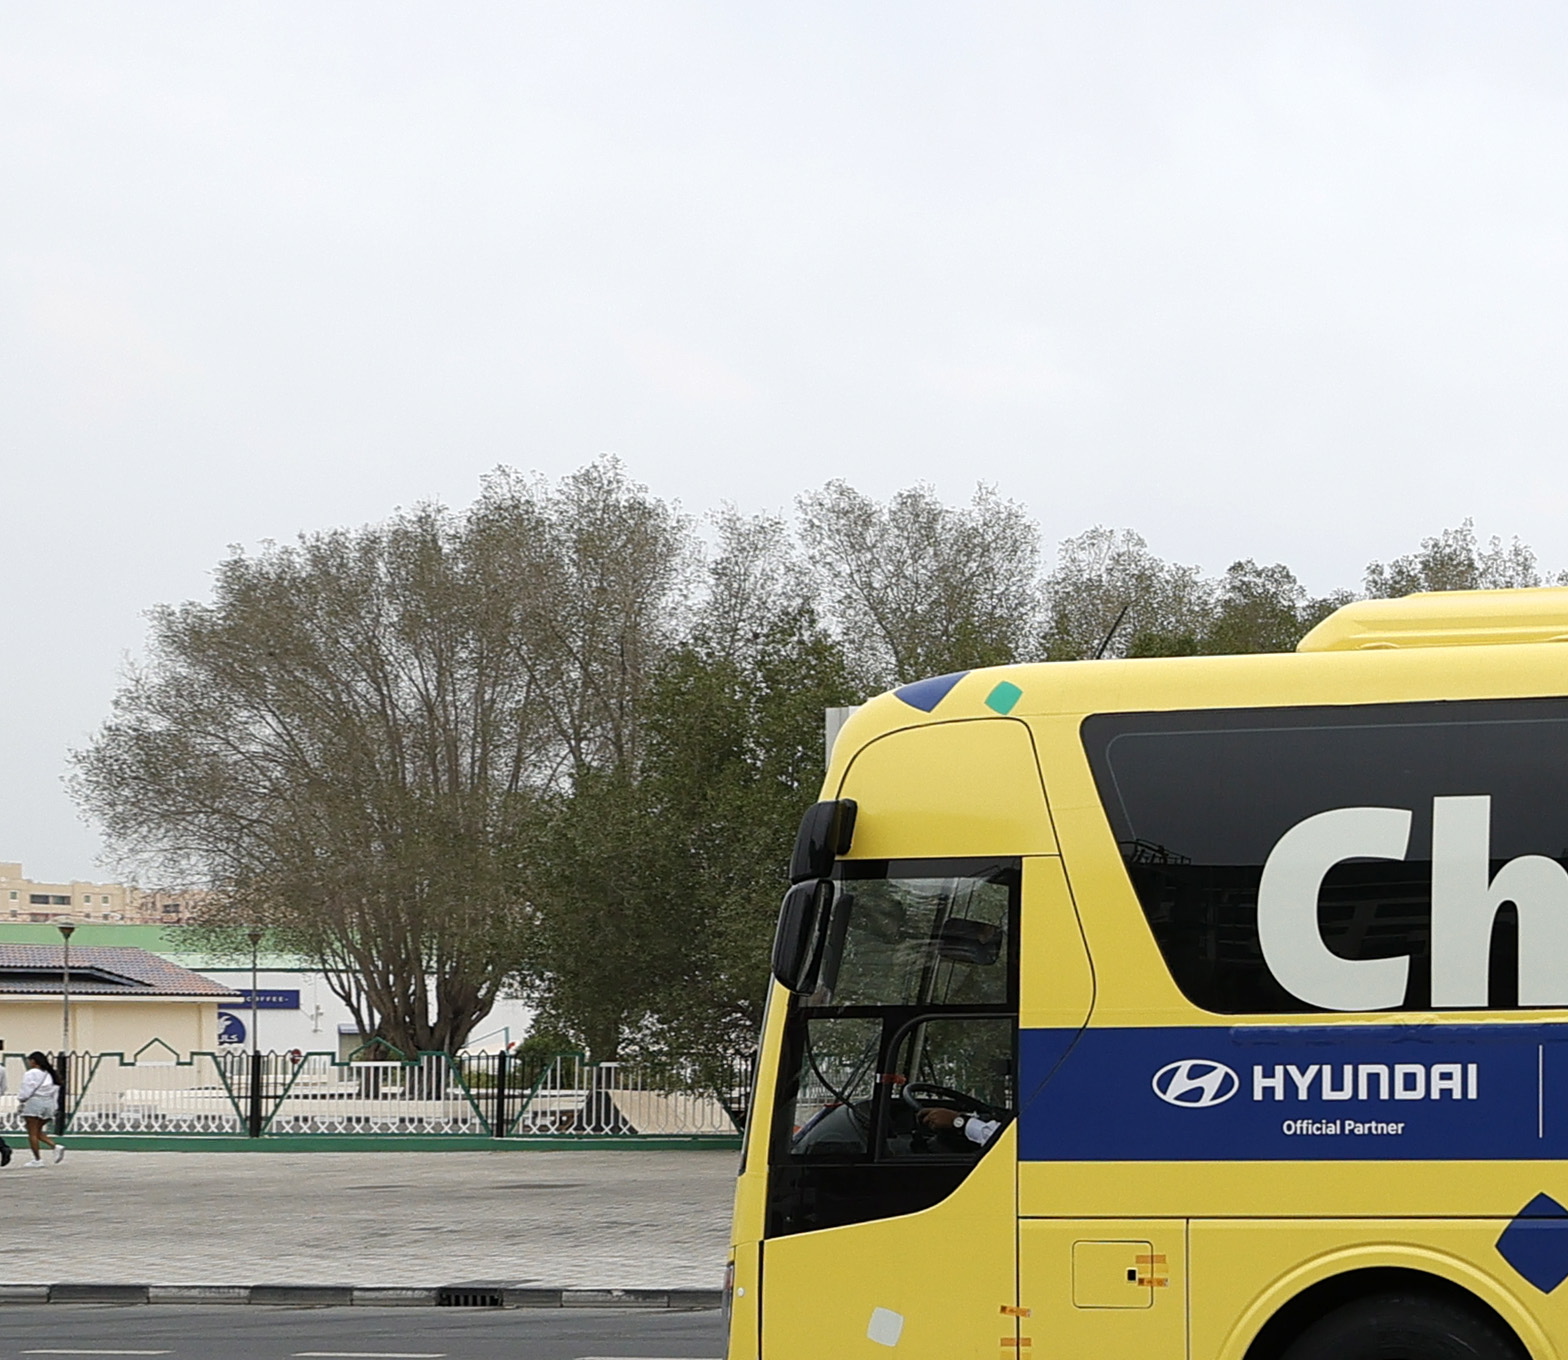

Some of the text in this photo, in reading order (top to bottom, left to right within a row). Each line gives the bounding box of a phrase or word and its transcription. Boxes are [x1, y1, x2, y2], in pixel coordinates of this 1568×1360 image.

[1253, 1063, 1478, 1101] HYUNDAI
[1282, 1119, 1405, 1135] Official Partner
